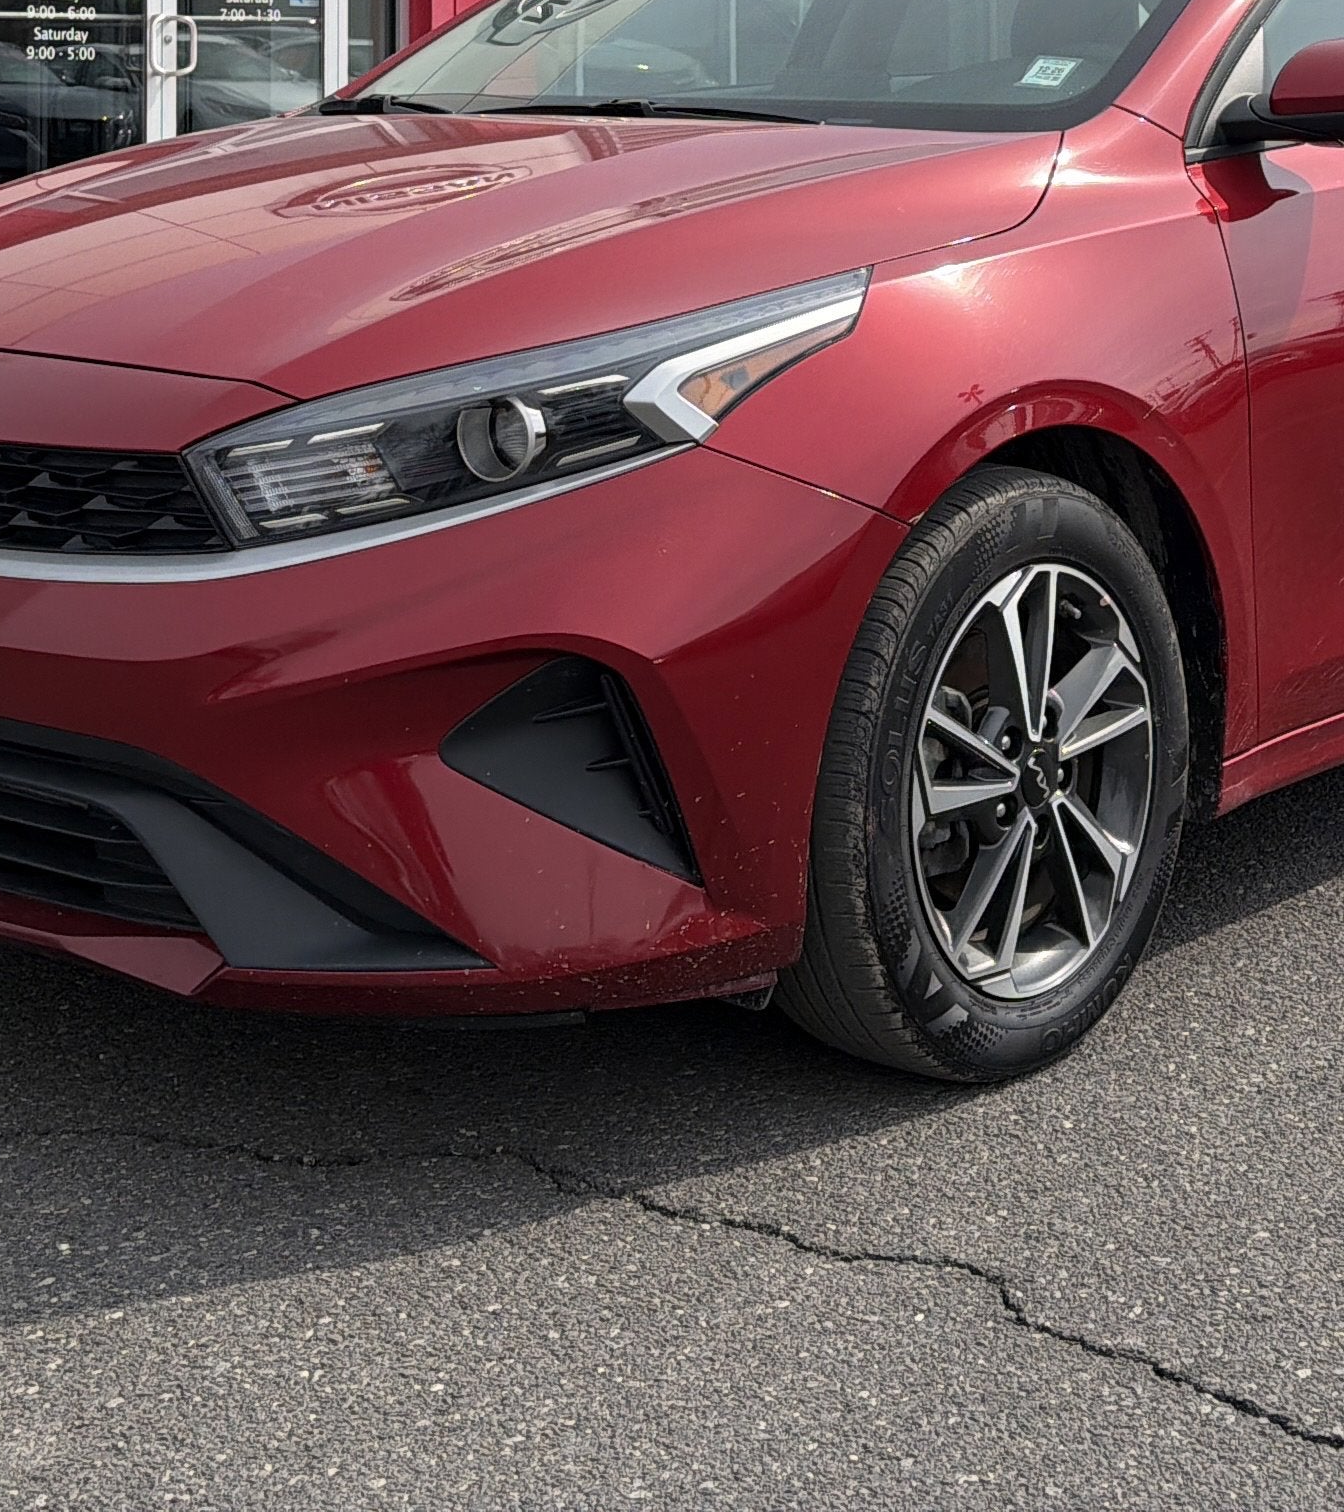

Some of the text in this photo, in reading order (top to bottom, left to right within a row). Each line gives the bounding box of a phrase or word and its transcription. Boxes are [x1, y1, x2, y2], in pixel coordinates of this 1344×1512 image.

[26, 5, 56, 19] 9:00
[33, 27, 89, 43] Saturday
[26, 46, 55, 60] 9:00
[67, 47, 96, 61] 5:00
